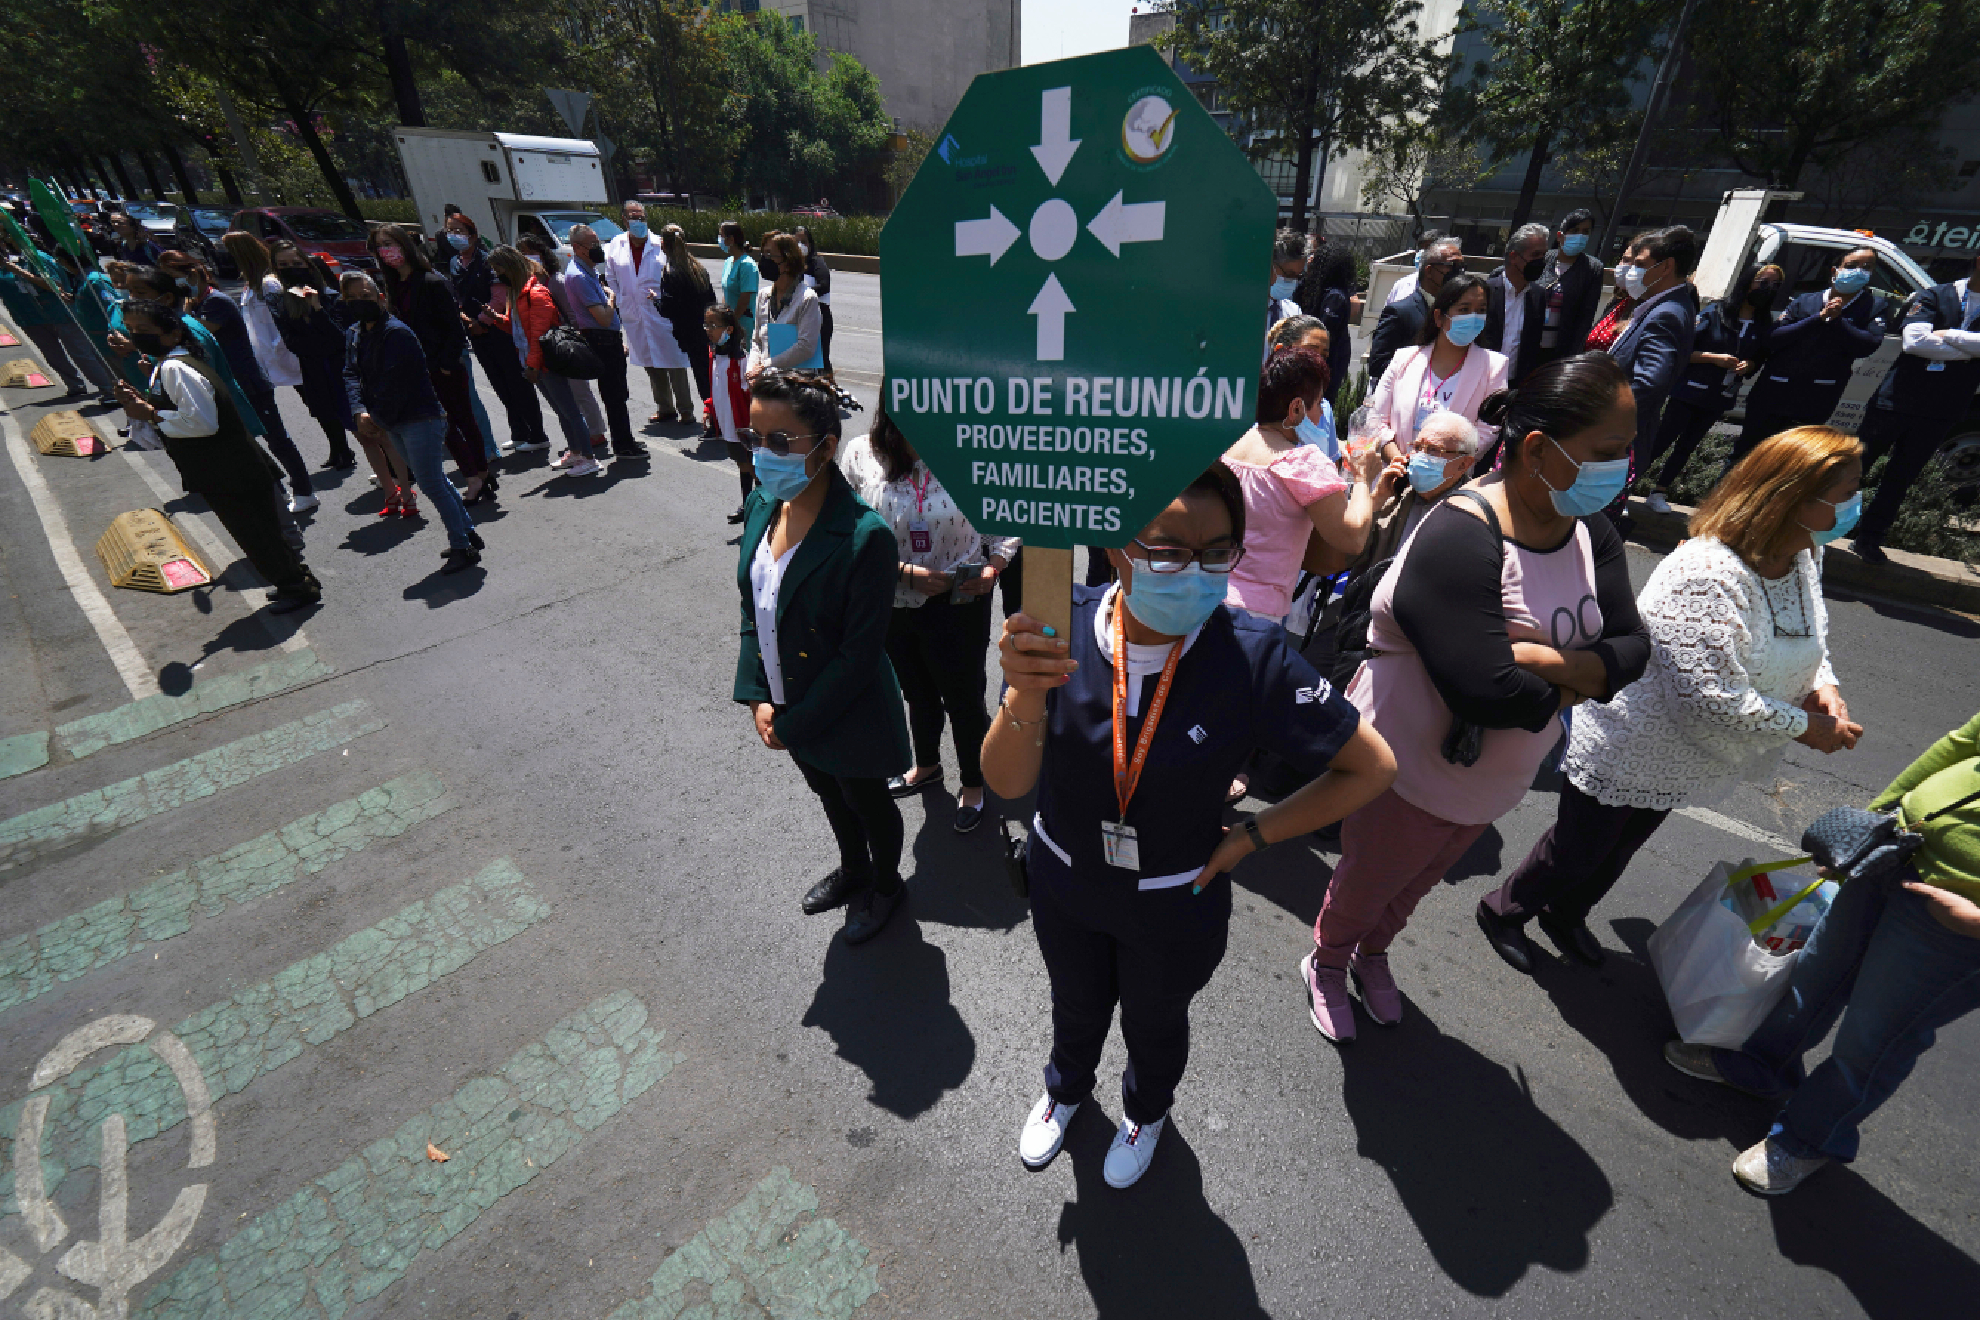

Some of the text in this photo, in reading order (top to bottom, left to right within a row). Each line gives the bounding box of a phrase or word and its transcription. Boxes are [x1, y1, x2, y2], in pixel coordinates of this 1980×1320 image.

[891, 367, 1246, 420] PUNTO DE REUNIÓN
[956, 424, 1156, 461] PROVEEDORES,
[972, 461, 1136, 501] FAMILIARES,
[982, 498, 1121, 532] PACIENTES
